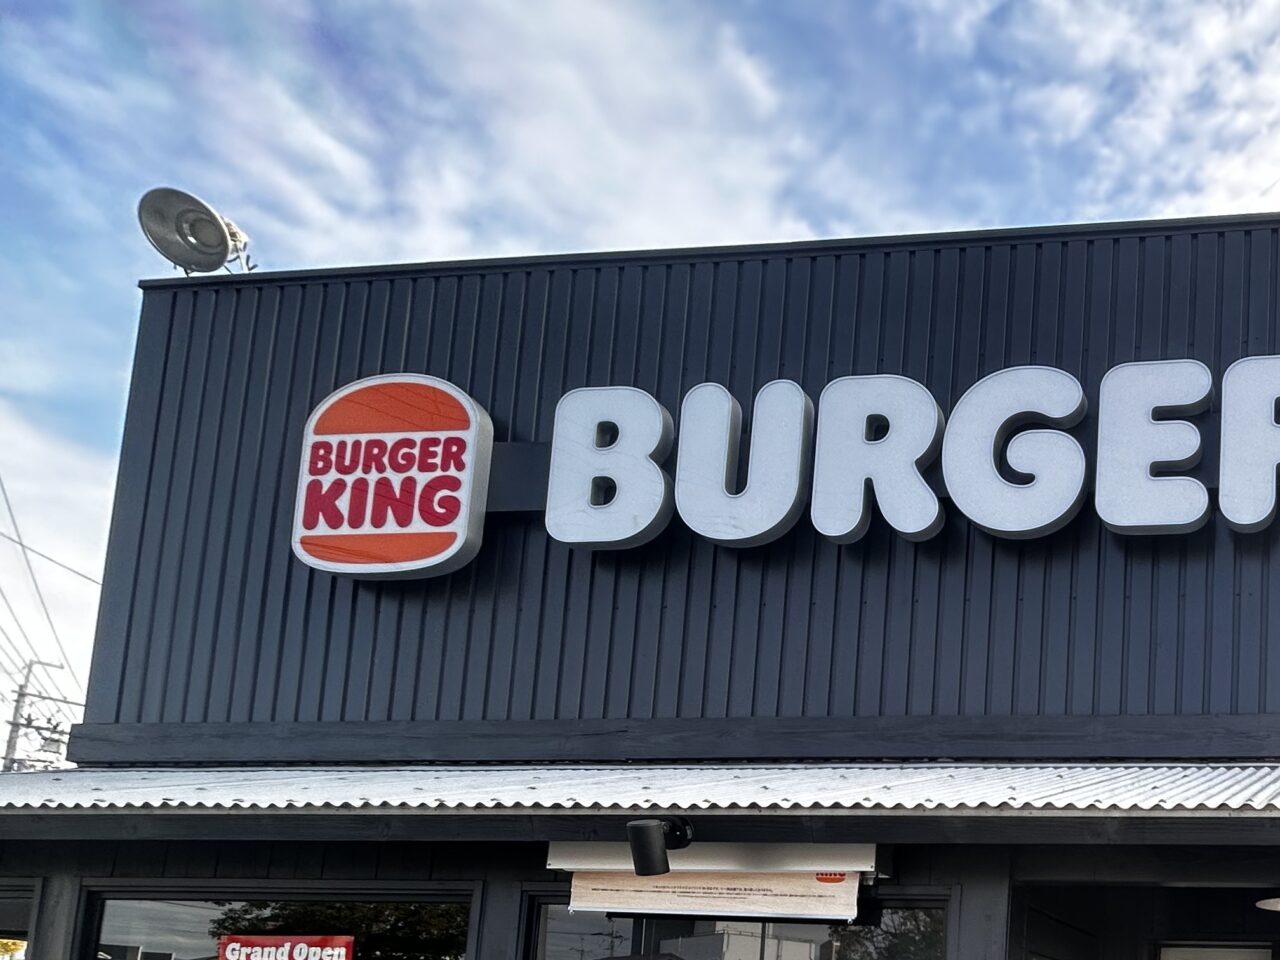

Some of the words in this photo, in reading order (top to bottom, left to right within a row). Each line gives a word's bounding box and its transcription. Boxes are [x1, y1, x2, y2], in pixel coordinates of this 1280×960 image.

[308, 436, 467, 476] BURGER
[302, 475, 462, 530] KING
[225, 942, 291, 960] Grand
